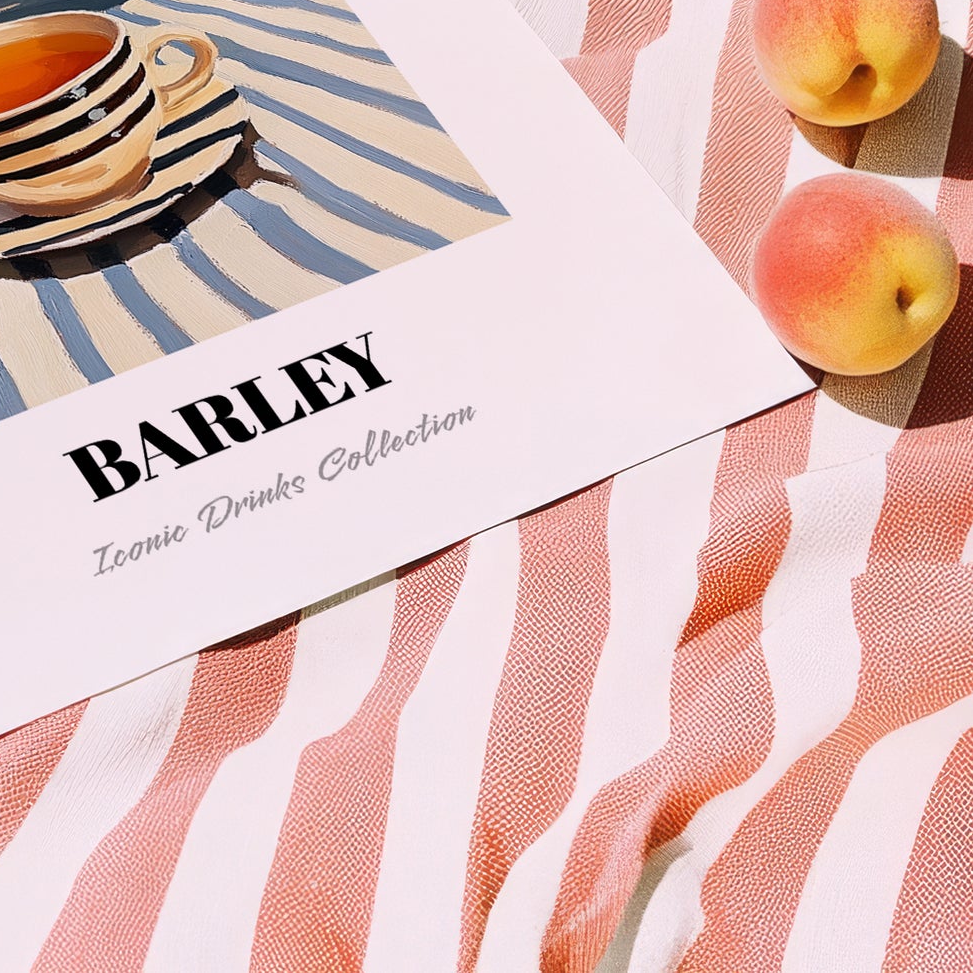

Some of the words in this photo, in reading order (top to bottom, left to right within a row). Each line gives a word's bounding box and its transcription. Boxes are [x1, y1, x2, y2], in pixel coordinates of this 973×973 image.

[63, 331, 392, 503] BARLEY
[93, 524, 189, 577] Iconic
[198, 473, 305, 533] Drinks
[318, 405, 476, 481] Collection
